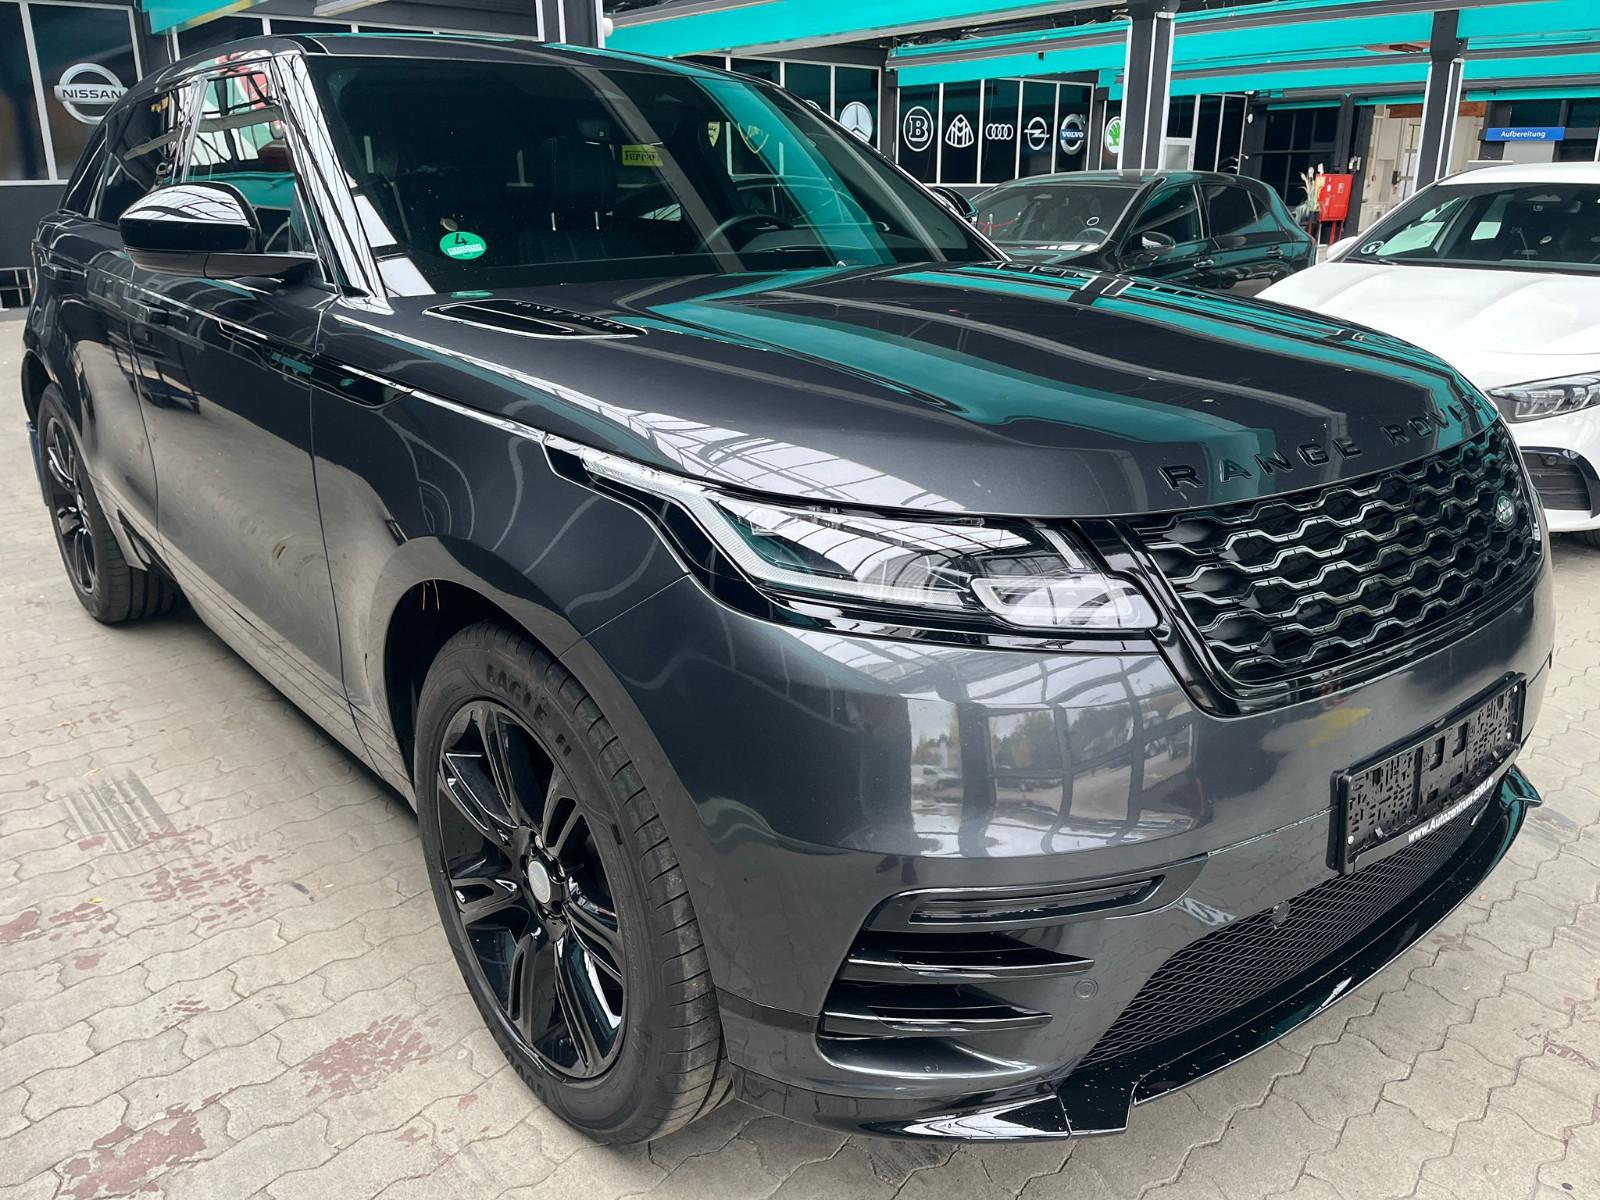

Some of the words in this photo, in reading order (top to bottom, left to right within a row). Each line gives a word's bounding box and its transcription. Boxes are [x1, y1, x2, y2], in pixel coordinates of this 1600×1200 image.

[62, 89, 122, 99] NISSAN
[1500, 130, 1546, 138] Aufbereitung
[1158, 438, 1362, 490] RANGE
